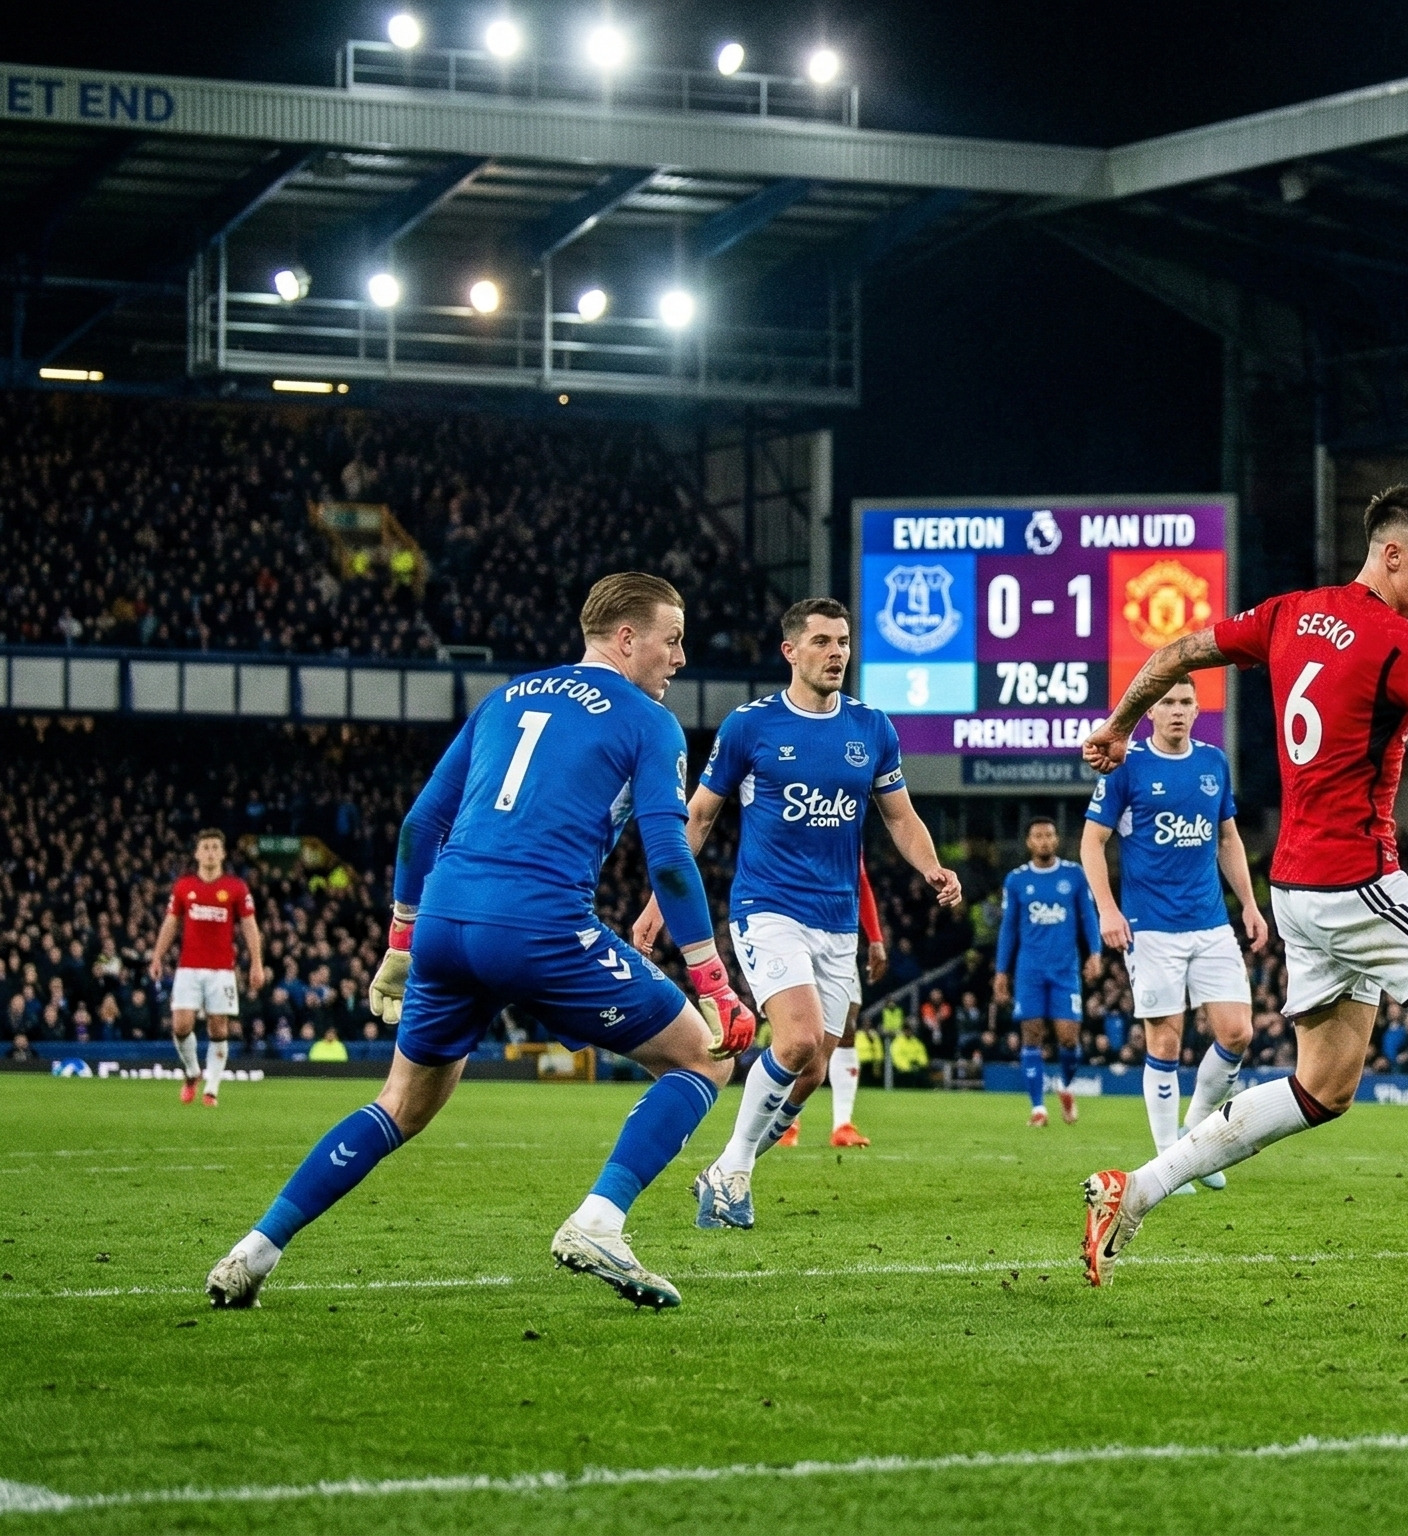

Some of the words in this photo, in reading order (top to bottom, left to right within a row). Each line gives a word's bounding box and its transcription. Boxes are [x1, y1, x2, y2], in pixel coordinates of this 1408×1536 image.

[8, 77, 64, 116] ET
[80, 82, 174, 123] END
[893, 517, 1004, 550] EVERTON
[1080, 514, 1140, 547] MAN
[1143, 513, 1196, 547] UTD
[987, 574, 1020, 639] 0
[1067, 574, 1092, 638] 1
[1296, 612, 1356, 651] SESKO
[505, 677, 612, 715] PICKFORD
[906, 667, 930, 707] 3
[996, 661, 1089, 706] 78:45
[1284, 661, 1323, 765] 6
[953, 718, 1049, 749] PREMIER
[494, 710, 552, 812] 1
[783, 783, 857, 822] Stake
[805, 816, 840, 828] .com
[1154, 811, 1213, 845] Stake
